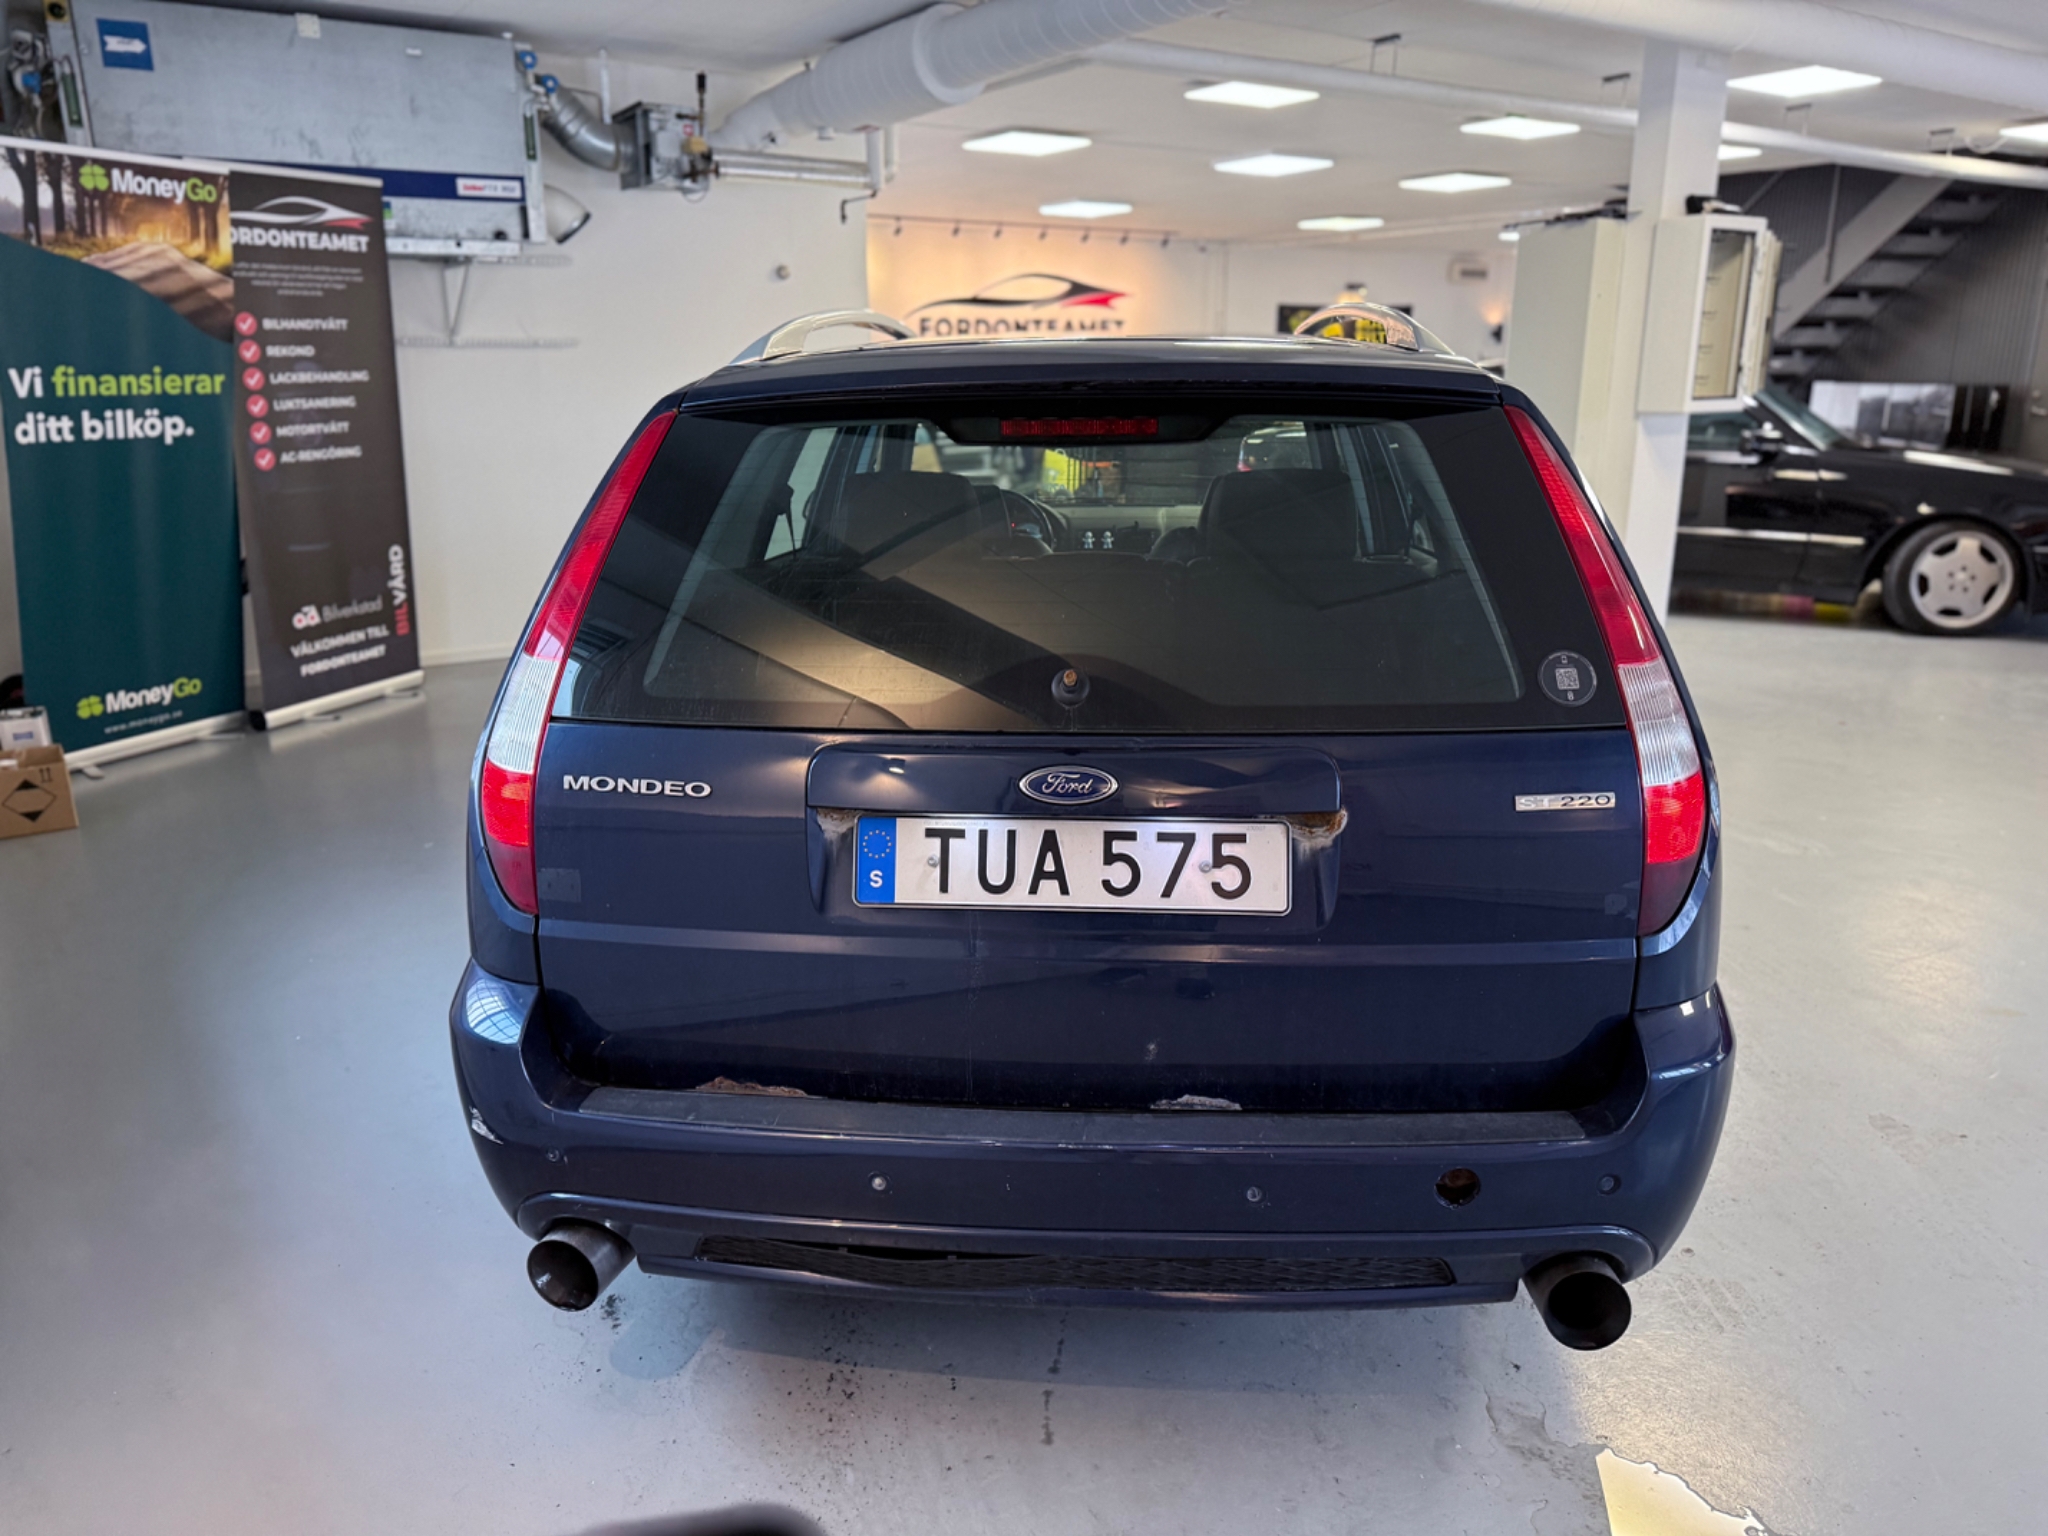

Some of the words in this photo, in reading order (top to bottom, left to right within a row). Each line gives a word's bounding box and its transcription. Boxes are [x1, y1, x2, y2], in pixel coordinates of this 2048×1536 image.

[110, 167, 217, 204] MoneyGo
[262, 317, 348, 331] BILHANDTVÄTT
[265, 345, 316, 357] REKOND
[8, 366, 44, 399] Vi
[52, 365, 225, 397] finansierar
[269, 370, 370, 384] LACKBEHANDLING
[273, 396, 356, 411] LUKTSANERING
[14, 411, 75, 445] ditt
[81, 408, 194, 445] bilköp.
[276, 420, 350, 437] MOTORTVÄTT
[105, 677, 202, 714] MoneyGo
[563, 775, 712, 797] MONDEO
[1042, 772, 1094, 794] Ford
[1561, 794, 1611, 807] 220
[924, 827, 1070, 896] TUA
[1101, 830, 1251, 900] 575
[869, 870, 883, 888] S
